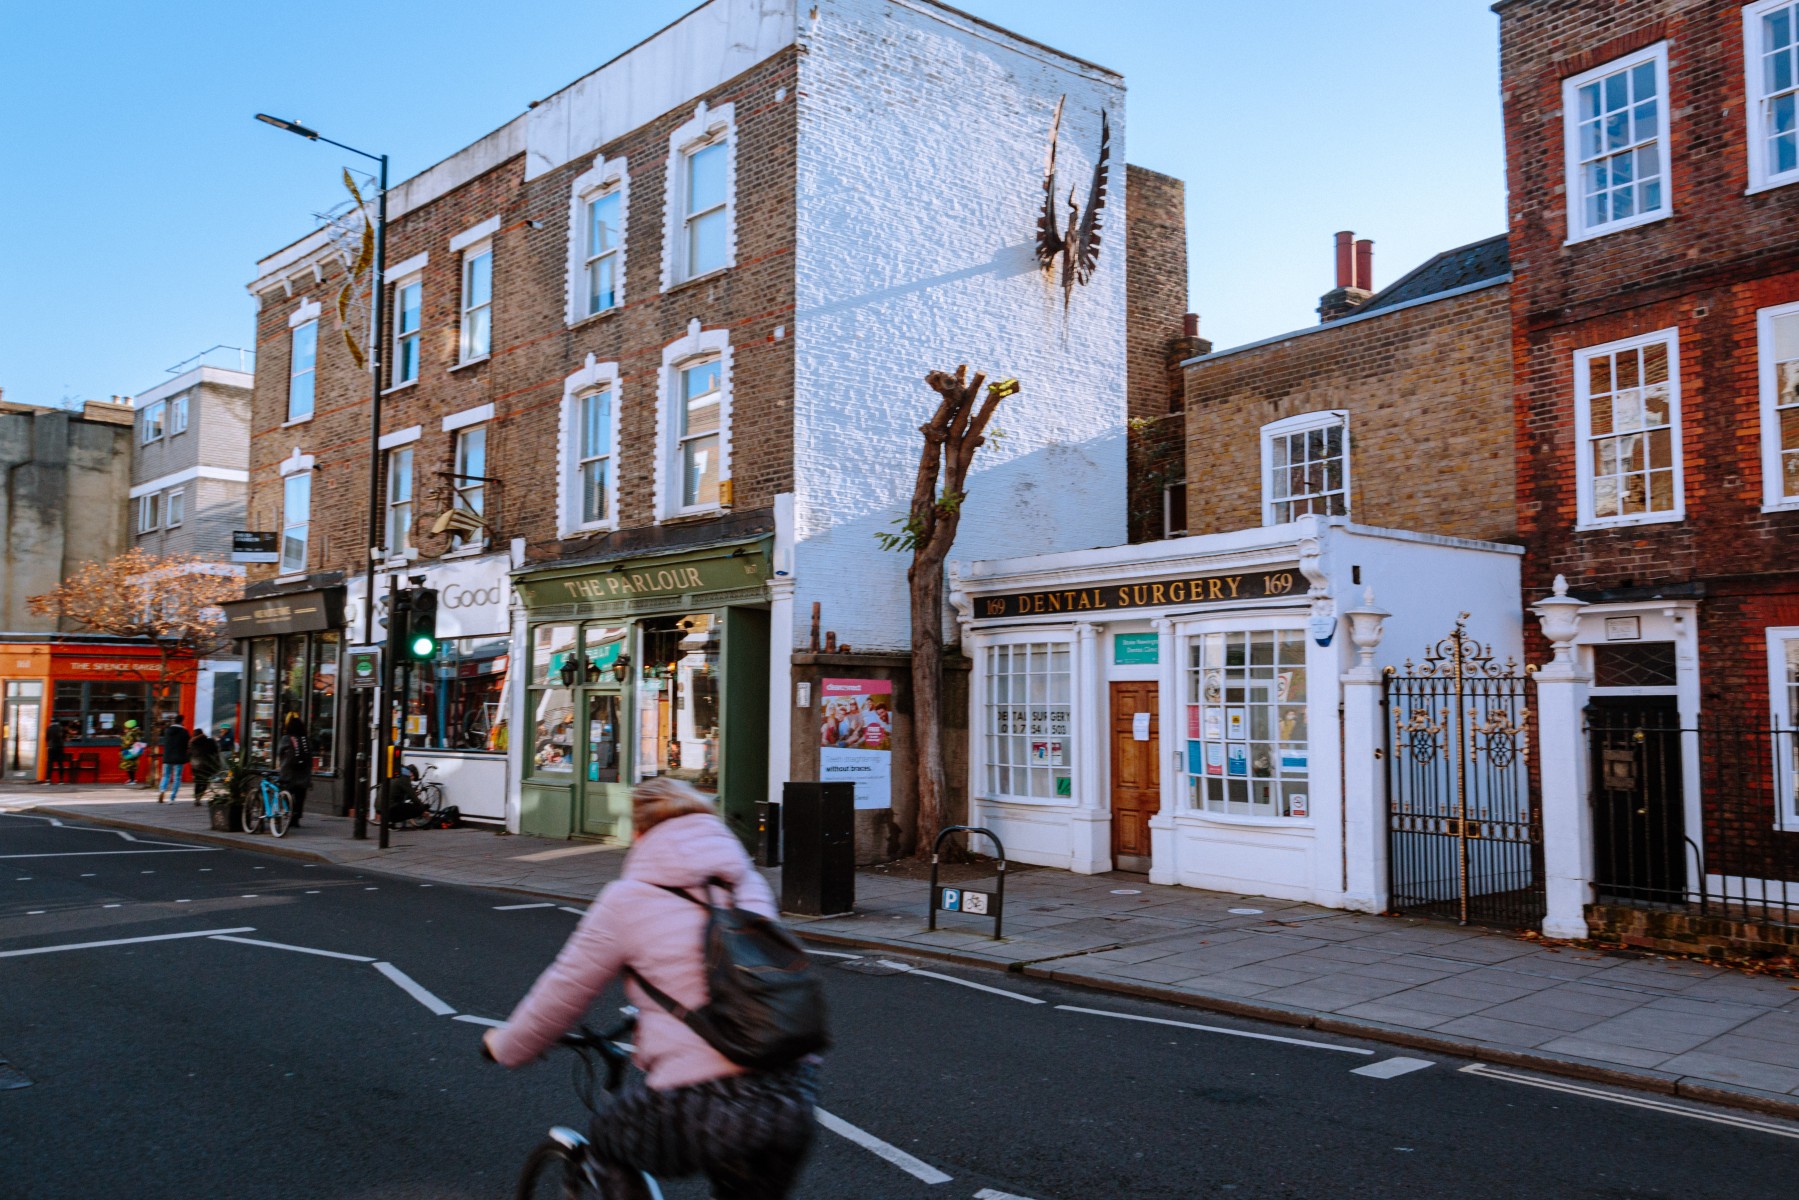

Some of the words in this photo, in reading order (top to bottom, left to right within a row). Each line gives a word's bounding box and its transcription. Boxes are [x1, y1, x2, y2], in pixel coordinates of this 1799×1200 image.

[443, 578, 501, 609] Good
[564, 579, 605, 598] THE
[609, 567, 704, 595] PARLOUR
[986, 598, 1006, 615] 169
[1018, 589, 1107, 614] DENTAL
[1118, 576, 1243, 606] SURGERY
[1263, 573, 1293, 595] 169
[70, 662, 91, 670] THE
[93, 662, 130, 671] SPENCE
[132, 663, 164, 671] BAKER
[945, 890, 958, 909] P
